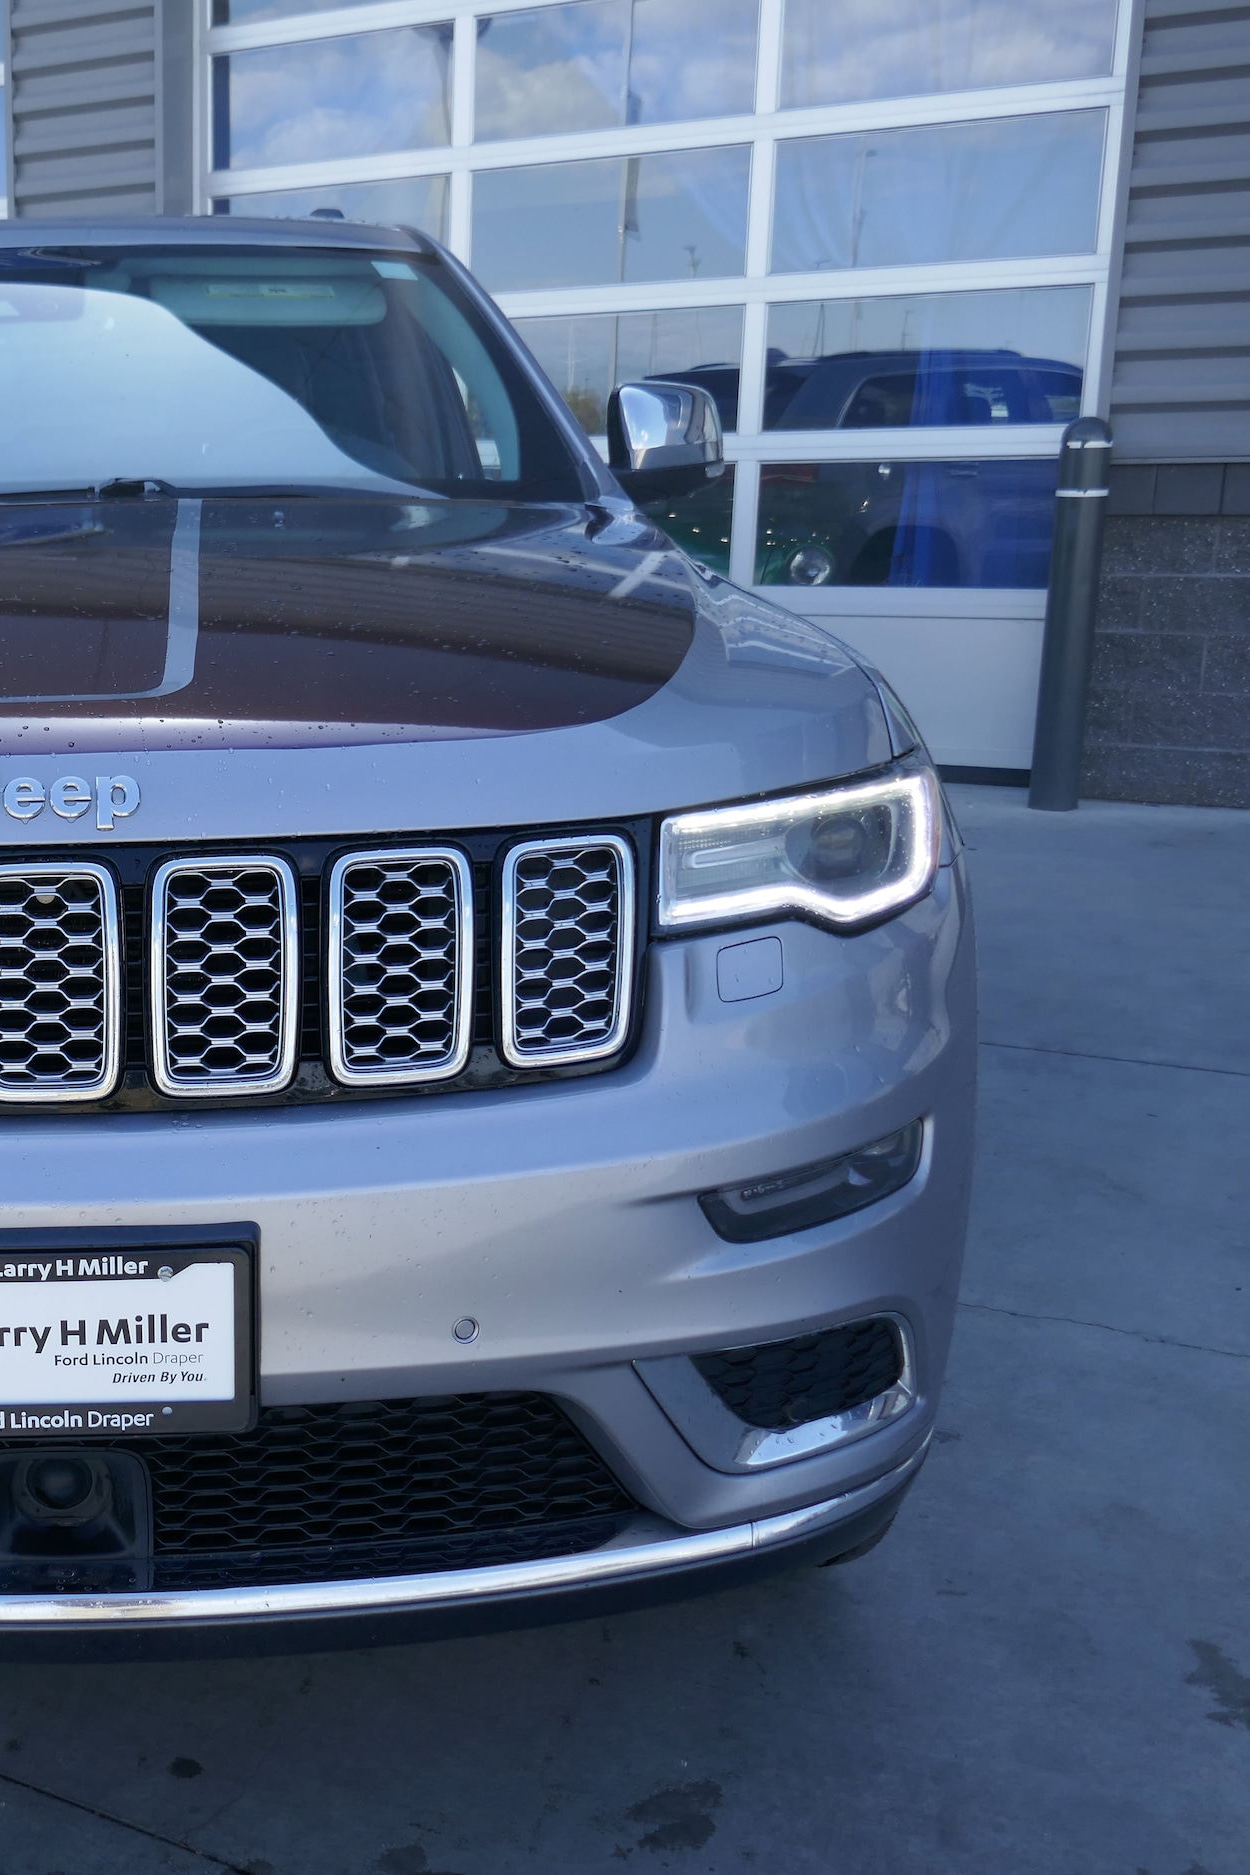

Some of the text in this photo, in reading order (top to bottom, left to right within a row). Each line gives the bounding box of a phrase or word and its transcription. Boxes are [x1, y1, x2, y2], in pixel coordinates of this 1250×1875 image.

[56, 1258, 74, 1277] H
[78, 1256, 149, 1276] Miller
[60, 1319, 86, 1346] H
[96, 1314, 210, 1345] Miller
[54, 1351, 204, 1368] Ford Lincoln Draper
[113, 1371, 156, 1384] Driven
[160, 1371, 178, 1386] By
[9, 1410, 83, 1430] Lincoln
[87, 1410, 154, 1431] Draper
